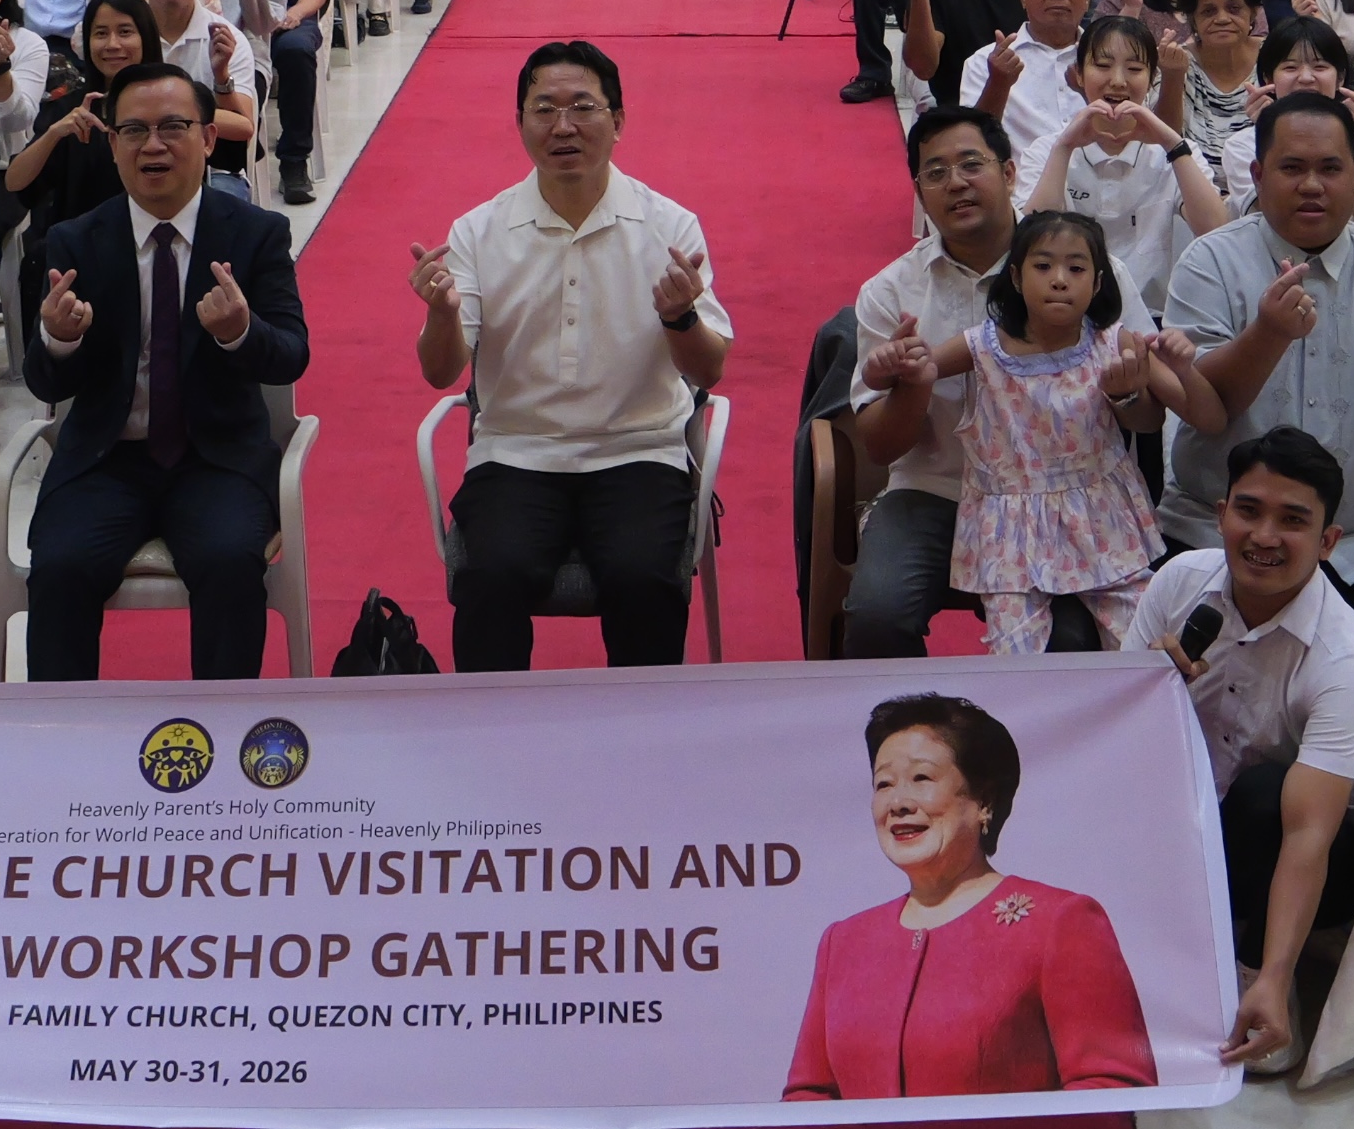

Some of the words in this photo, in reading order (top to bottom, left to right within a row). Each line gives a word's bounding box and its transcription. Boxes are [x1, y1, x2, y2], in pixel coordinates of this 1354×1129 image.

[69, 801, 149, 820] Heavenly
[230, 799, 268, 818] Holy
[274, 797, 375, 816] Community
[66, 827, 91, 842] for
[96, 826, 147, 842] World
[154, 827, 204, 842] Peace
[210, 825, 244, 841] and
[249, 824, 342, 840] Unification
[361, 821, 441, 841] Heavenly
[447, 820, 542, 840] Philippines
[52, 852, 297, 899] CHURCH
[318, 846, 650, 896] VISITATION
[670, 842, 802, 889] AND
[2, 933, 351, 980] WORKSHOP
[371, 925, 720, 979] GATHERING
[8, 1004, 120, 1028] FAMILY
[126, 1005, 257, 1032] CHURCH,
[267, 1005, 393, 1032] QUEZON
[403, 1003, 473, 1031] CITY,
[483, 999, 663, 1026] PHILIPPINES
[70, 1059, 136, 1083] MAY
[144, 1059, 230, 1087] 30-31,
[240, 1059, 308, 1084] 2026
